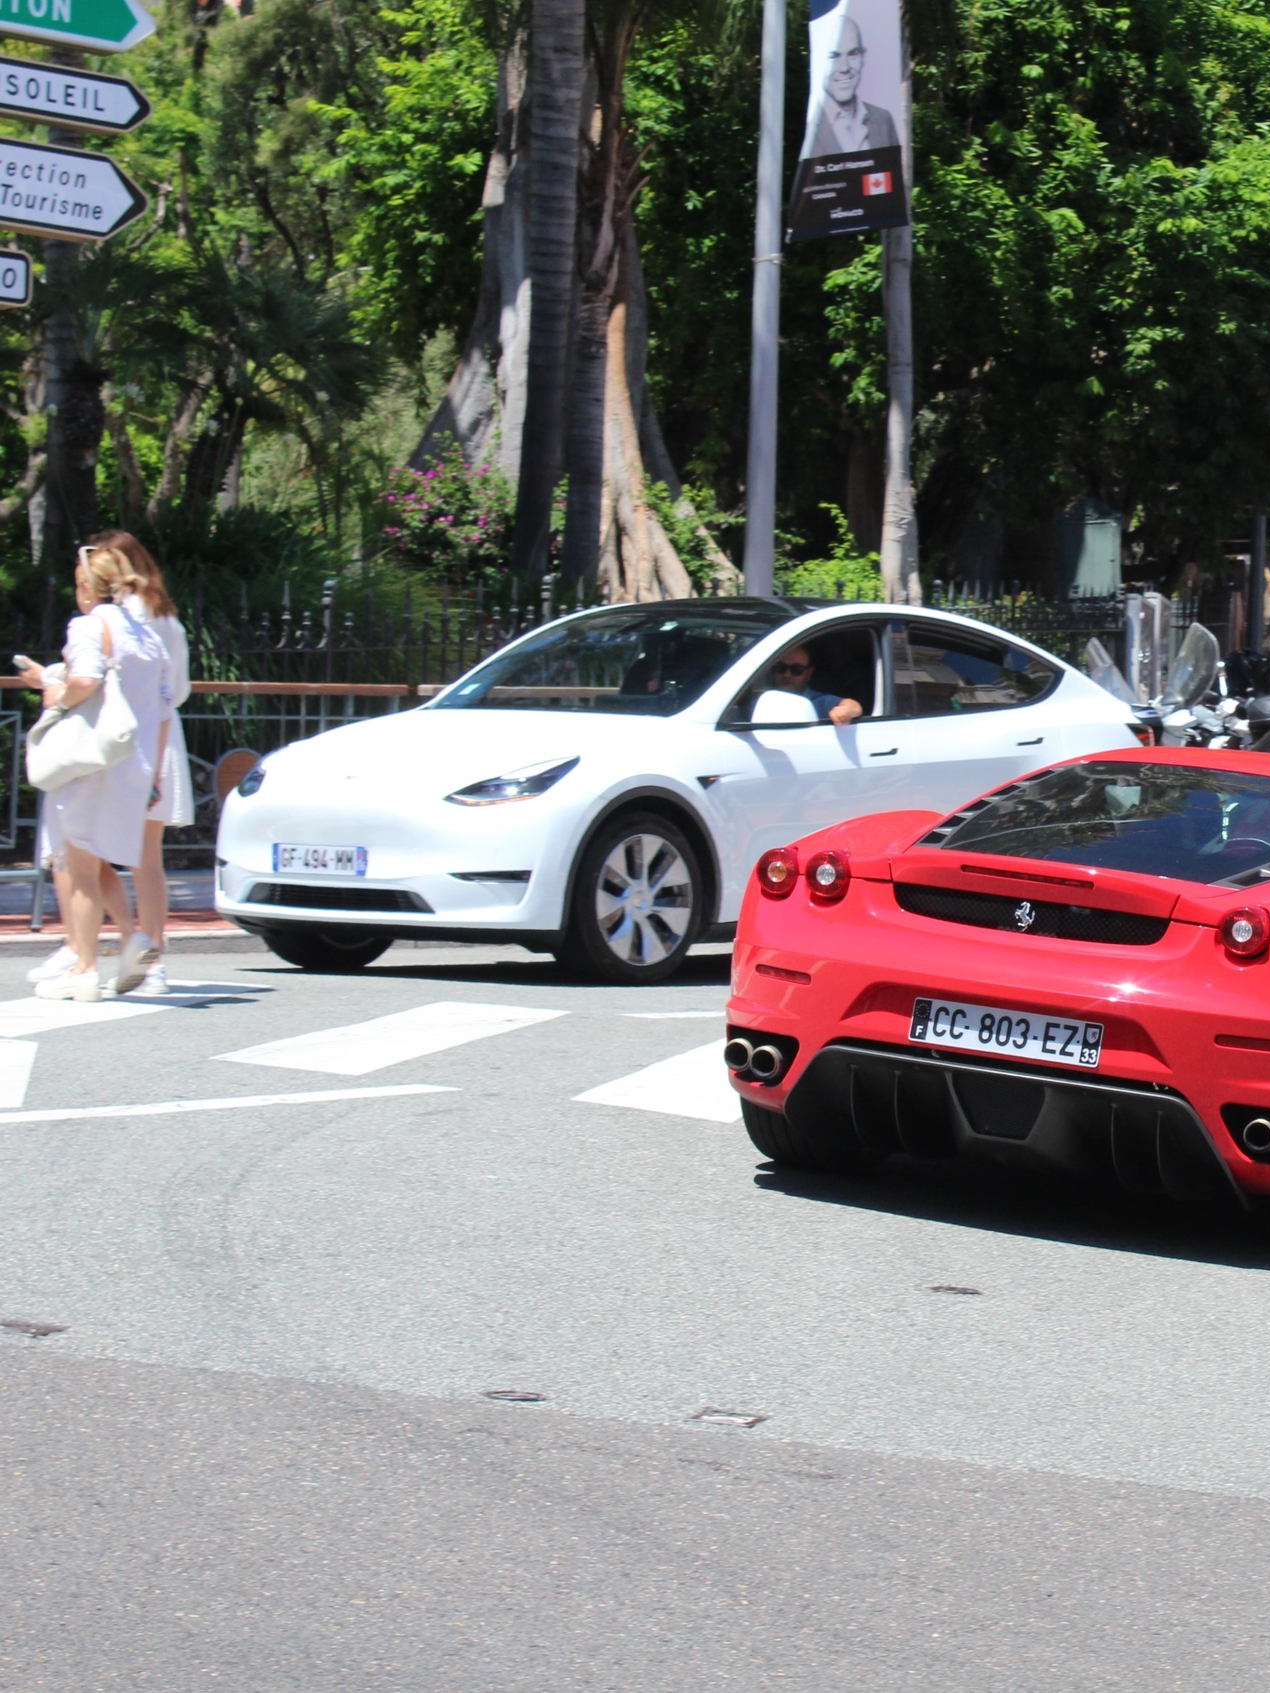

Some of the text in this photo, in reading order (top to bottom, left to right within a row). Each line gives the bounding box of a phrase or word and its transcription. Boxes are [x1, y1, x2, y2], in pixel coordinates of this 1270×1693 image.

[6, 74, 105, 112] SOLEIL
[0, 161, 87, 189] ection
[1, 184, 103, 220] Tourisme
[915, 1025, 923, 1037] F
[1081, 1048, 1097, 1063] 33
